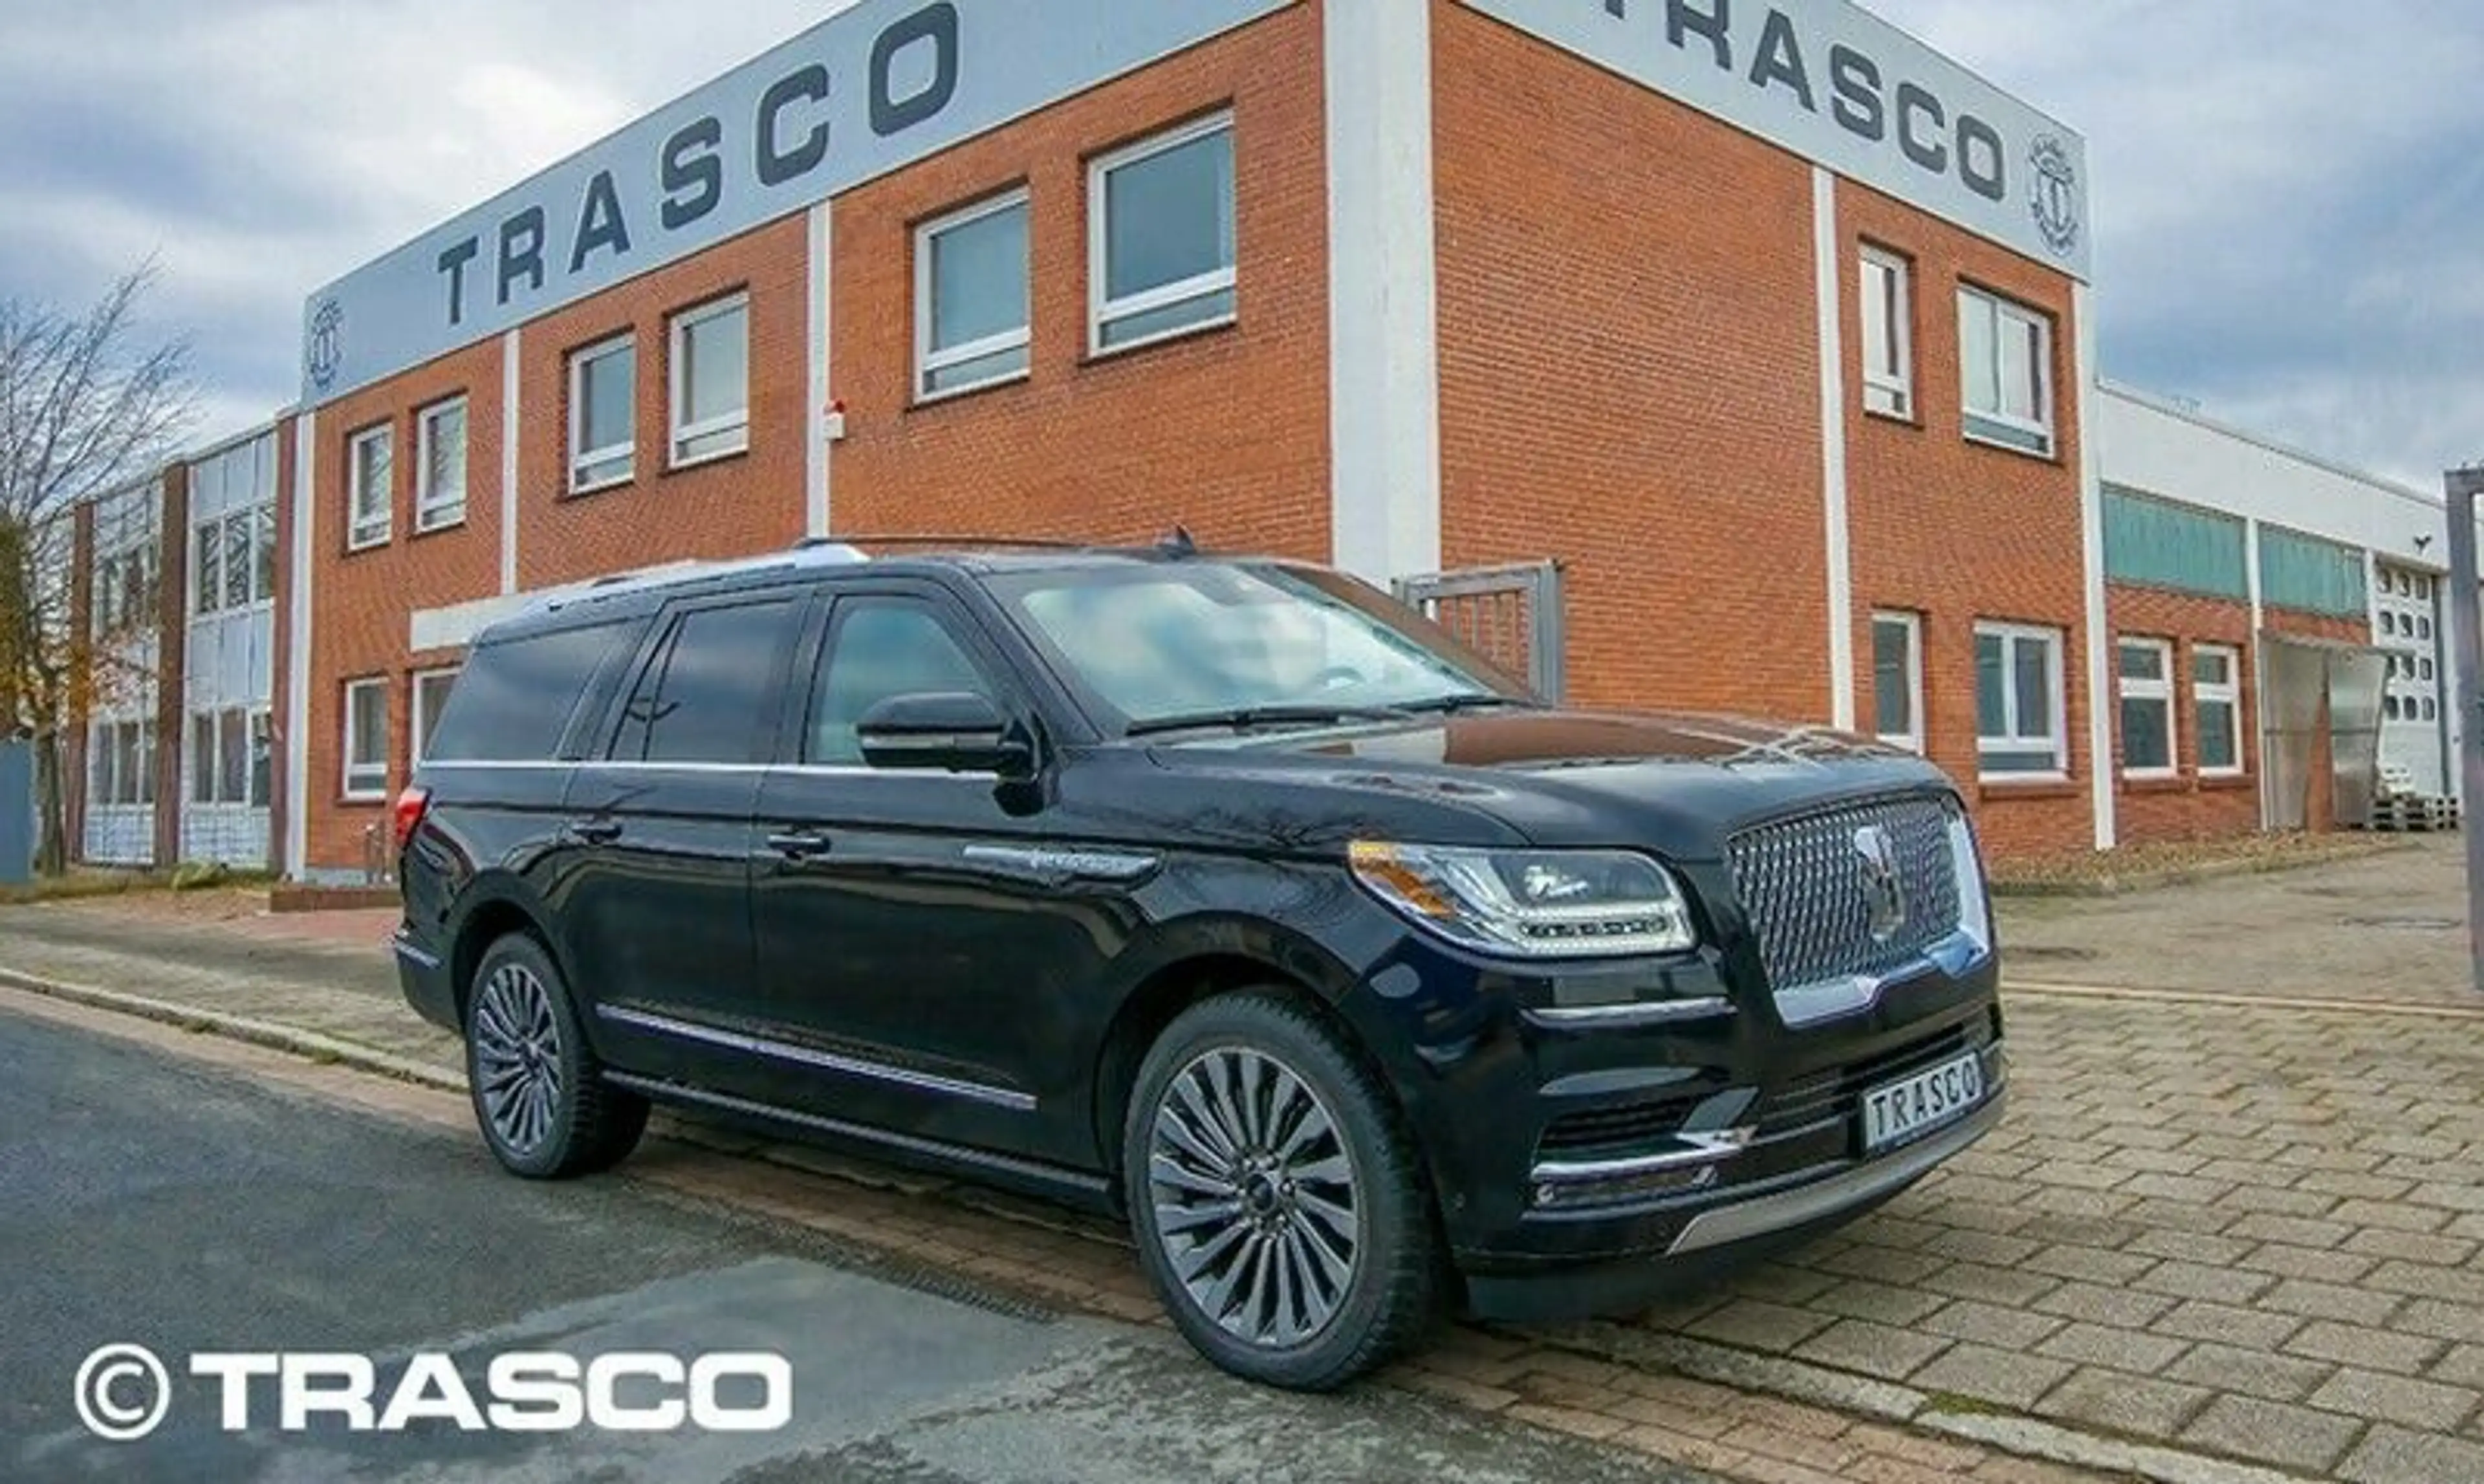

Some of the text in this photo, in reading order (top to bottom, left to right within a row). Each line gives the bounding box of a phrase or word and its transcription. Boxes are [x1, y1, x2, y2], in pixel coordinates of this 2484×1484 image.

[437, 1, 959, 325] TRASCO
[1604, 0, 2006, 201] RASCO
[1871, 1060, 1977, 1136] TRASCO
